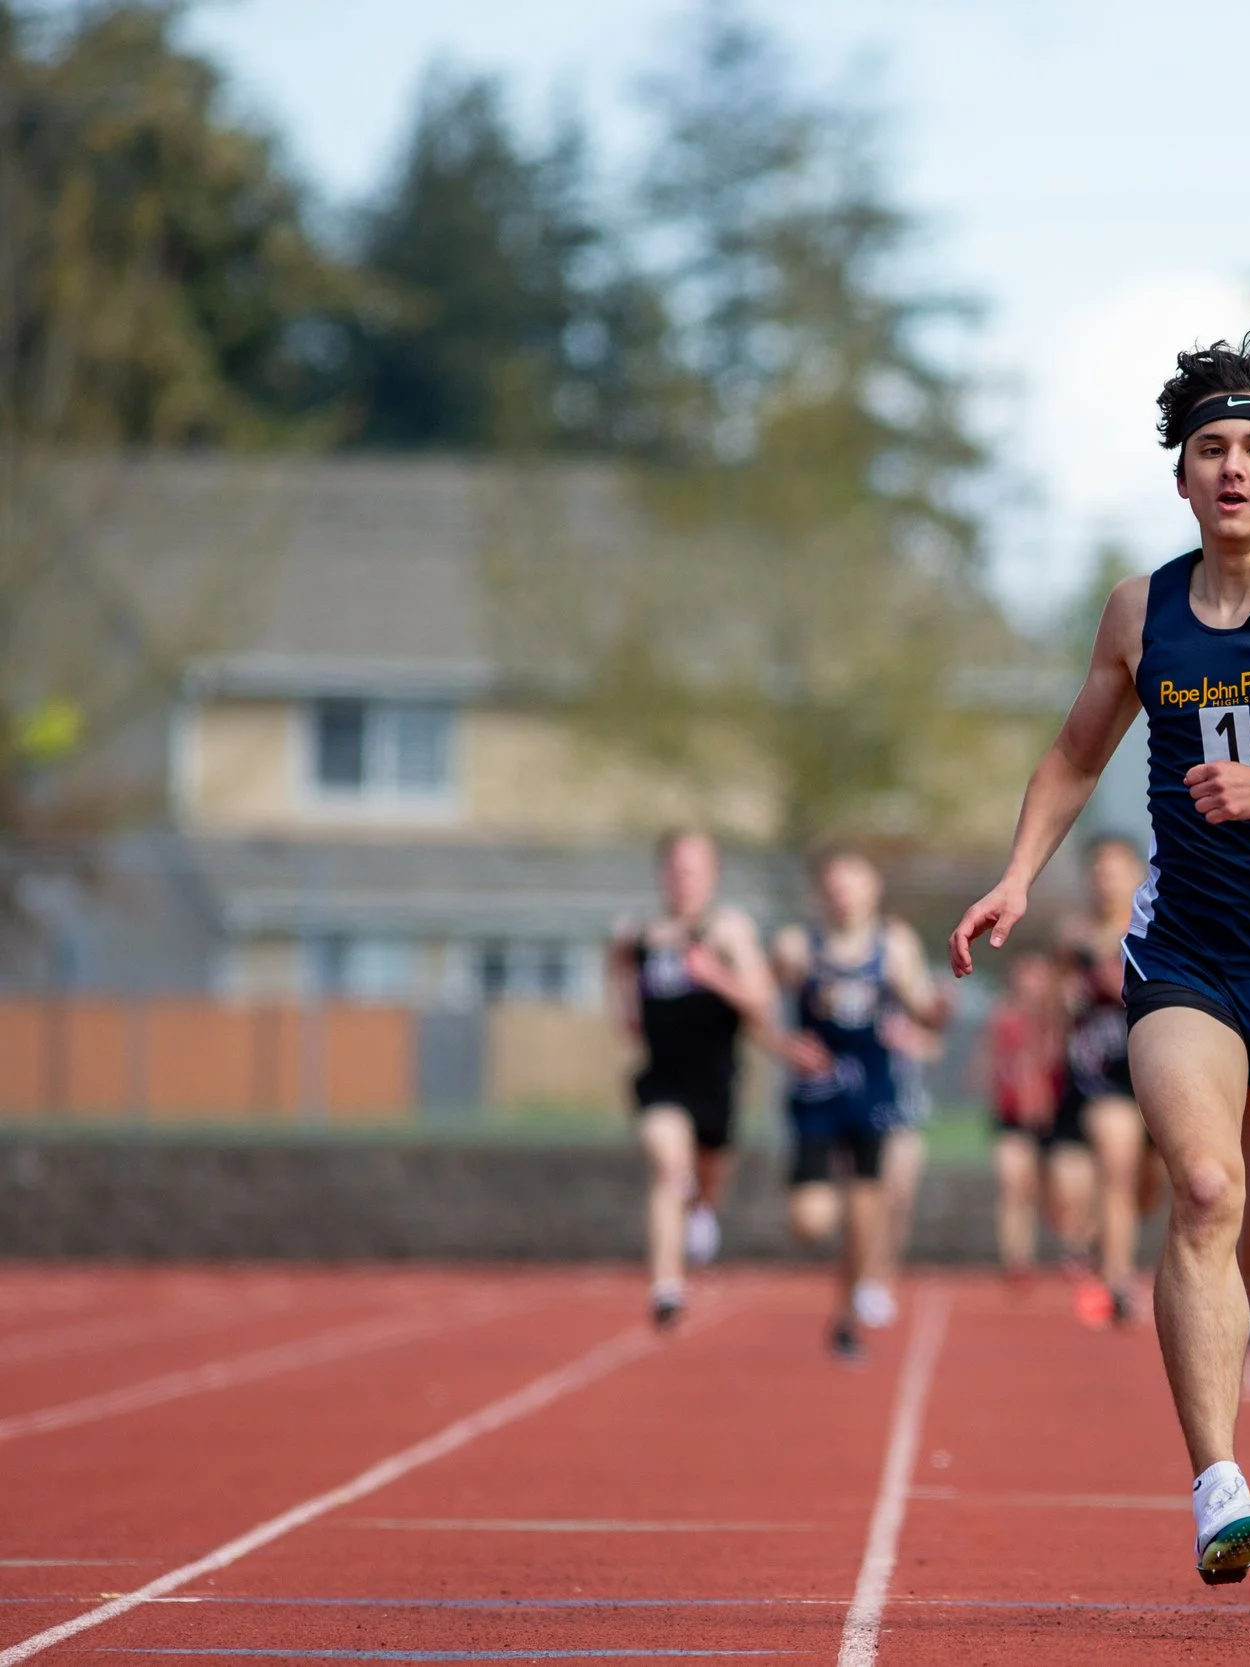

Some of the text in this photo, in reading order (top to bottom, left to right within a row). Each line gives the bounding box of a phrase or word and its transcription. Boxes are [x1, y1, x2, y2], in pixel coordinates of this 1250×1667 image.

[1160, 680, 1200, 708] Pope
[1199, 676, 1239, 708] John
[1212, 698, 1240, 707] HIGH
[1215, 711, 1240, 763] 1
